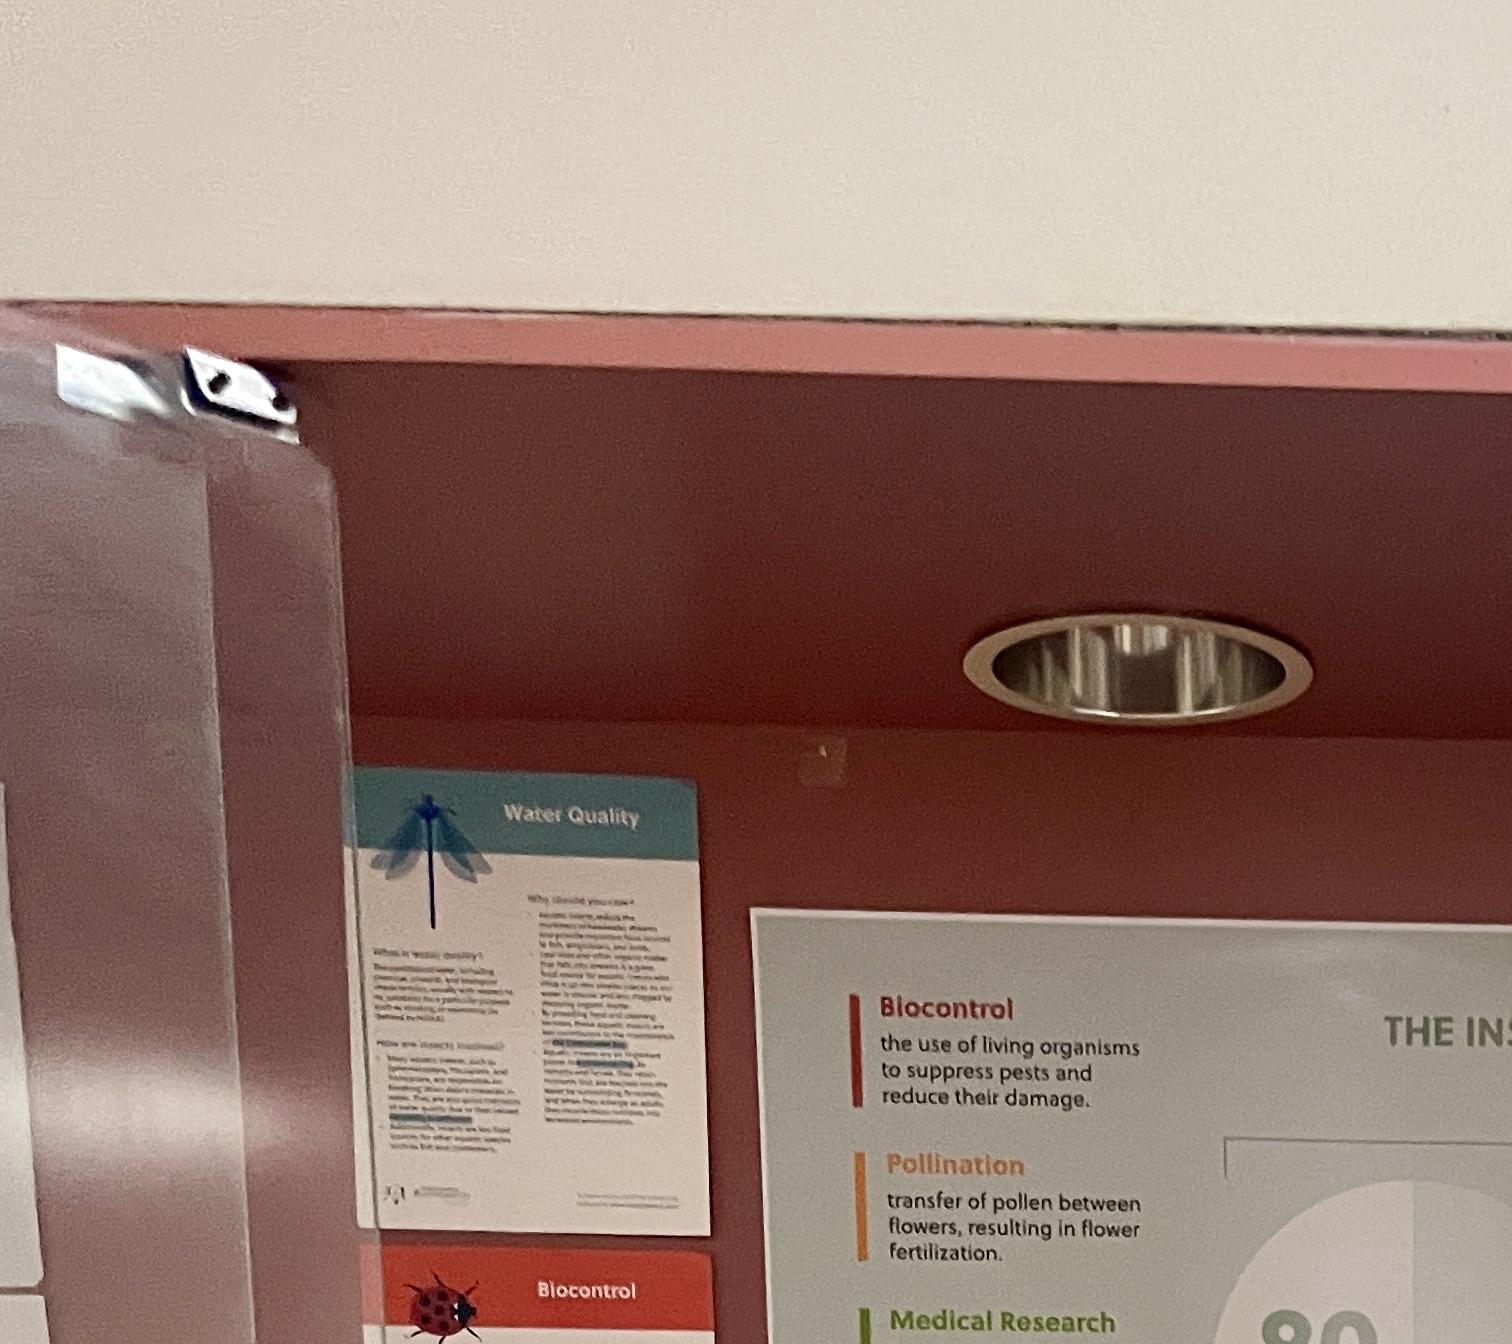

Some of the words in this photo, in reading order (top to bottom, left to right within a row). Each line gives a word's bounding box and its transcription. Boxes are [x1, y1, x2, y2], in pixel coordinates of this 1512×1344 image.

[503, 804, 561, 823] Water
[567, 806, 639, 829] Quality
[880, 996, 1012, 1019] Biocontrol
[1384, 1016, 1453, 1046] THE
[880, 1033, 911, 1052] the
[918, 1039, 950, 1053] use
[957, 1035, 977, 1053] of
[982, 1036, 1033, 1059] living
[1040, 1040, 1139, 1060] organisms
[882, 1062, 900, 1078] to
[907, 1065, 992, 1083] suppress
[1000, 1066, 1049, 1085] pests
[1056, 1064, 1091, 1082] and
[882, 1087, 949, 1105] reduce
[955, 1087, 998, 1105] their
[1005, 1088, 1089, 1111] damage.
[887, 1153, 1023, 1175] Pollination
[887, 1191, 961, 1209] transfer
[968, 1192, 986, 1210] of
[993, 1193, 1052, 1214] pollen
[1059, 1194, 1140, 1212] between
[889, 1216, 961, 1237] flowers,
[968, 1219, 1051, 1241] resulting
[1059, 1220, 1075, 1236] in
[1082, 1219, 1139, 1238] flower
[890, 1242, 1001, 1261] fertilization.
[538, 1281, 635, 1299] Biocontrol
[890, 1309, 992, 1331] Medical
[1001, 1312, 1114, 1332] Research
